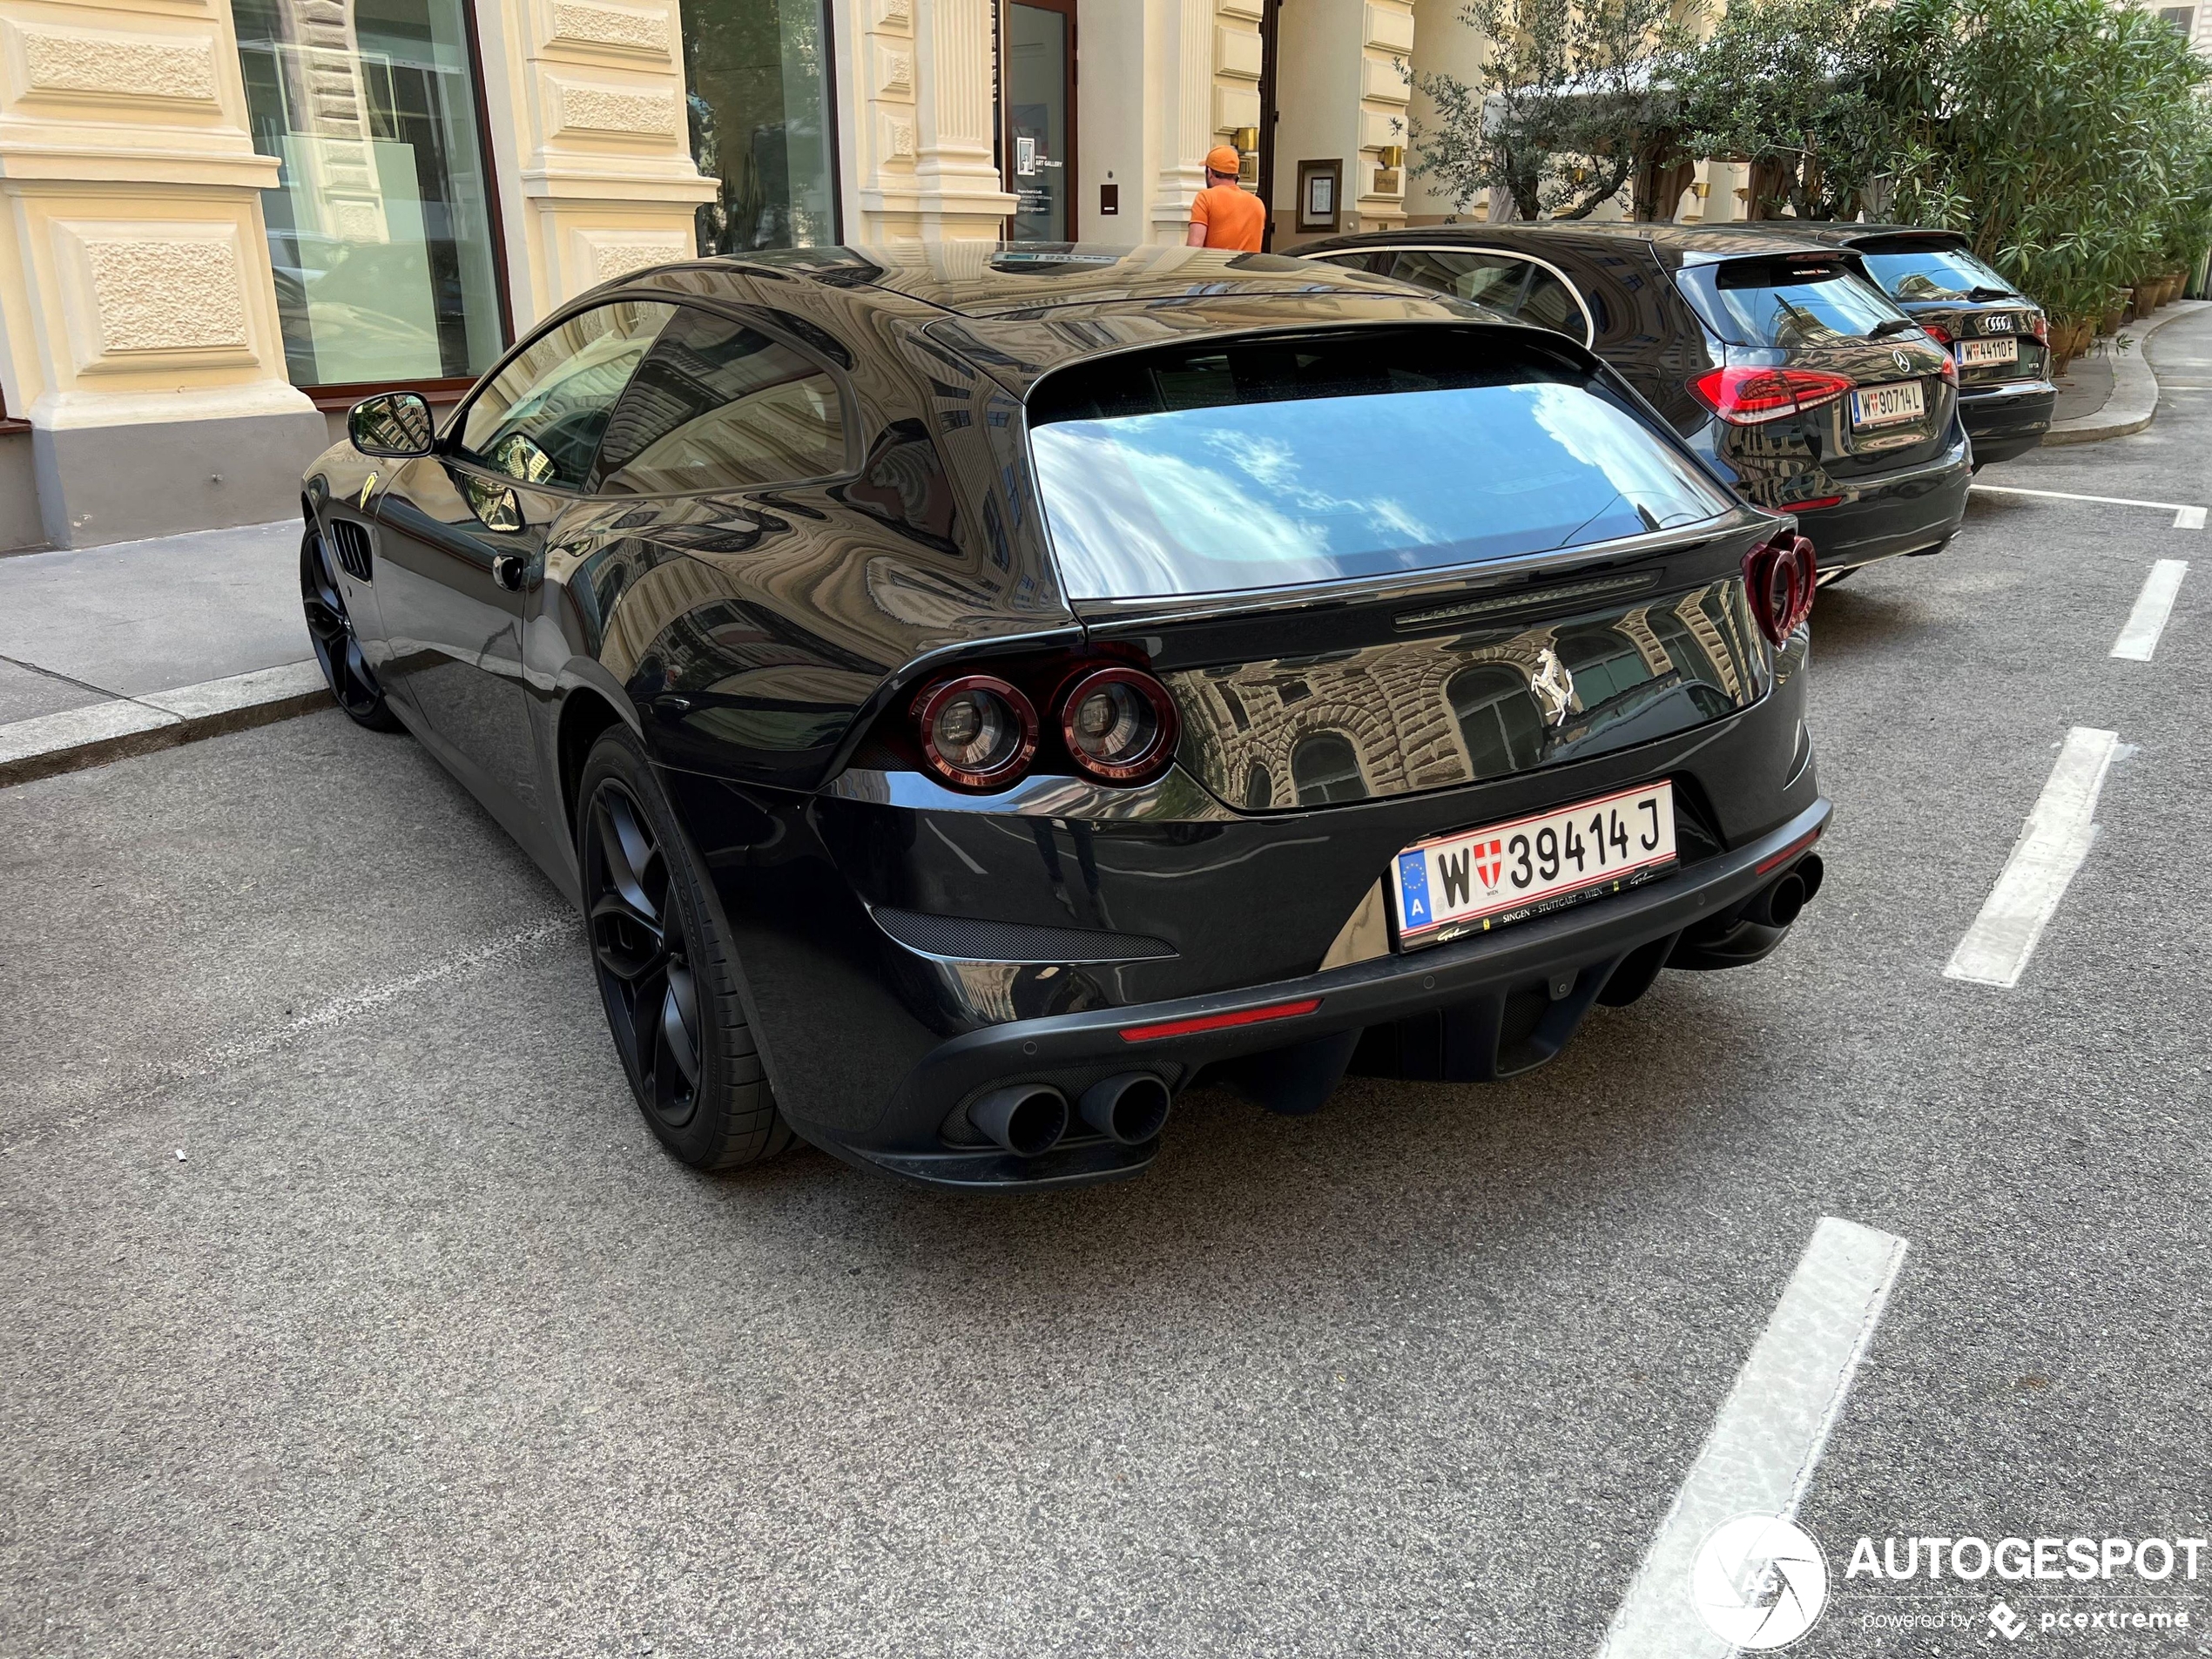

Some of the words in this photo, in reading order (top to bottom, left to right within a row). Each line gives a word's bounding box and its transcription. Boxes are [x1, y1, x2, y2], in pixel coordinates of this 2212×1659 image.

[1965, 343, 1973, 361] W
[1861, 394, 1871, 418] W
[1437, 847, 1470, 908] W
[1507, 808, 1629, 890] 39414
[1637, 797, 1659, 851] J
[1411, 898, 1425, 916] A
[1502, 907, 1531, 924] SINGEN
[1538, 894, 1577, 914] STUTTGART
[1584, 887, 1603, 900] WIEN
